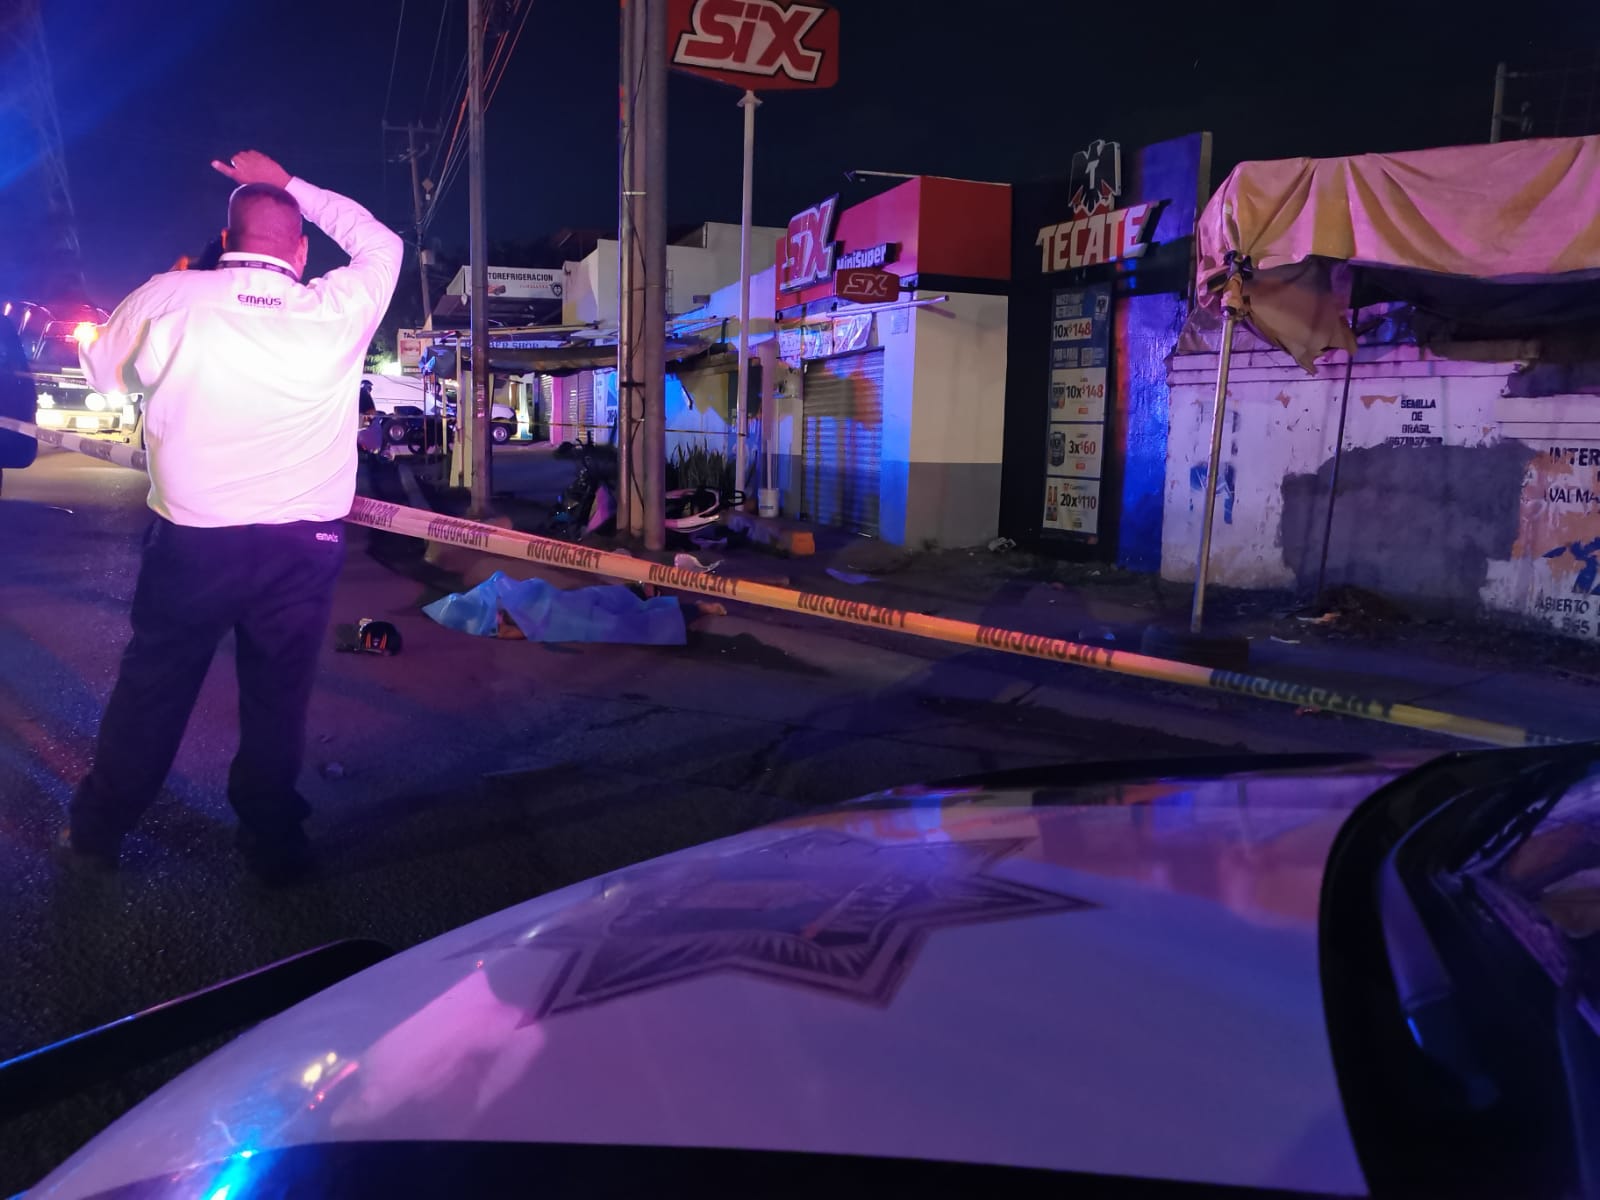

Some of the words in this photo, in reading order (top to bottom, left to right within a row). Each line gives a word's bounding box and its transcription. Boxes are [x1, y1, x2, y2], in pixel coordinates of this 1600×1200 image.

[1035, 202, 1154, 273] TECATE
[488, 272, 553, 281] TOREFRIGERACION
[1401, 399, 1436, 409] SEMILLA
[1411, 411, 1423, 421] DE
